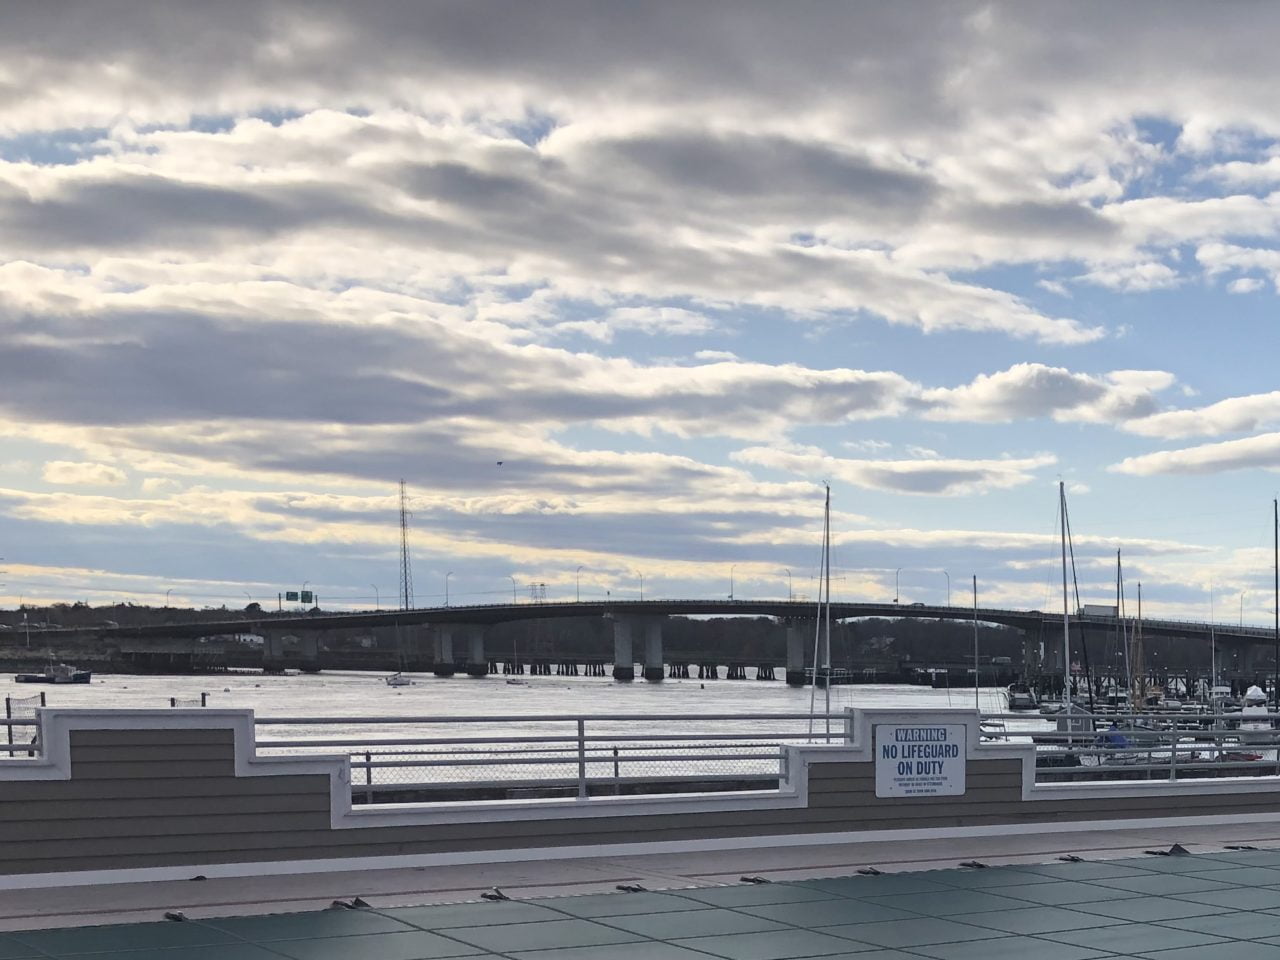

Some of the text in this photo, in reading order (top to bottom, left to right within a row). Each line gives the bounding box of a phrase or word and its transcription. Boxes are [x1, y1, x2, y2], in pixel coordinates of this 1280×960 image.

[897, 729, 945, 741] WARNING
[882, 744, 959, 759] NO LIFEGUARD
[897, 760, 944, 775] ON DUTY
